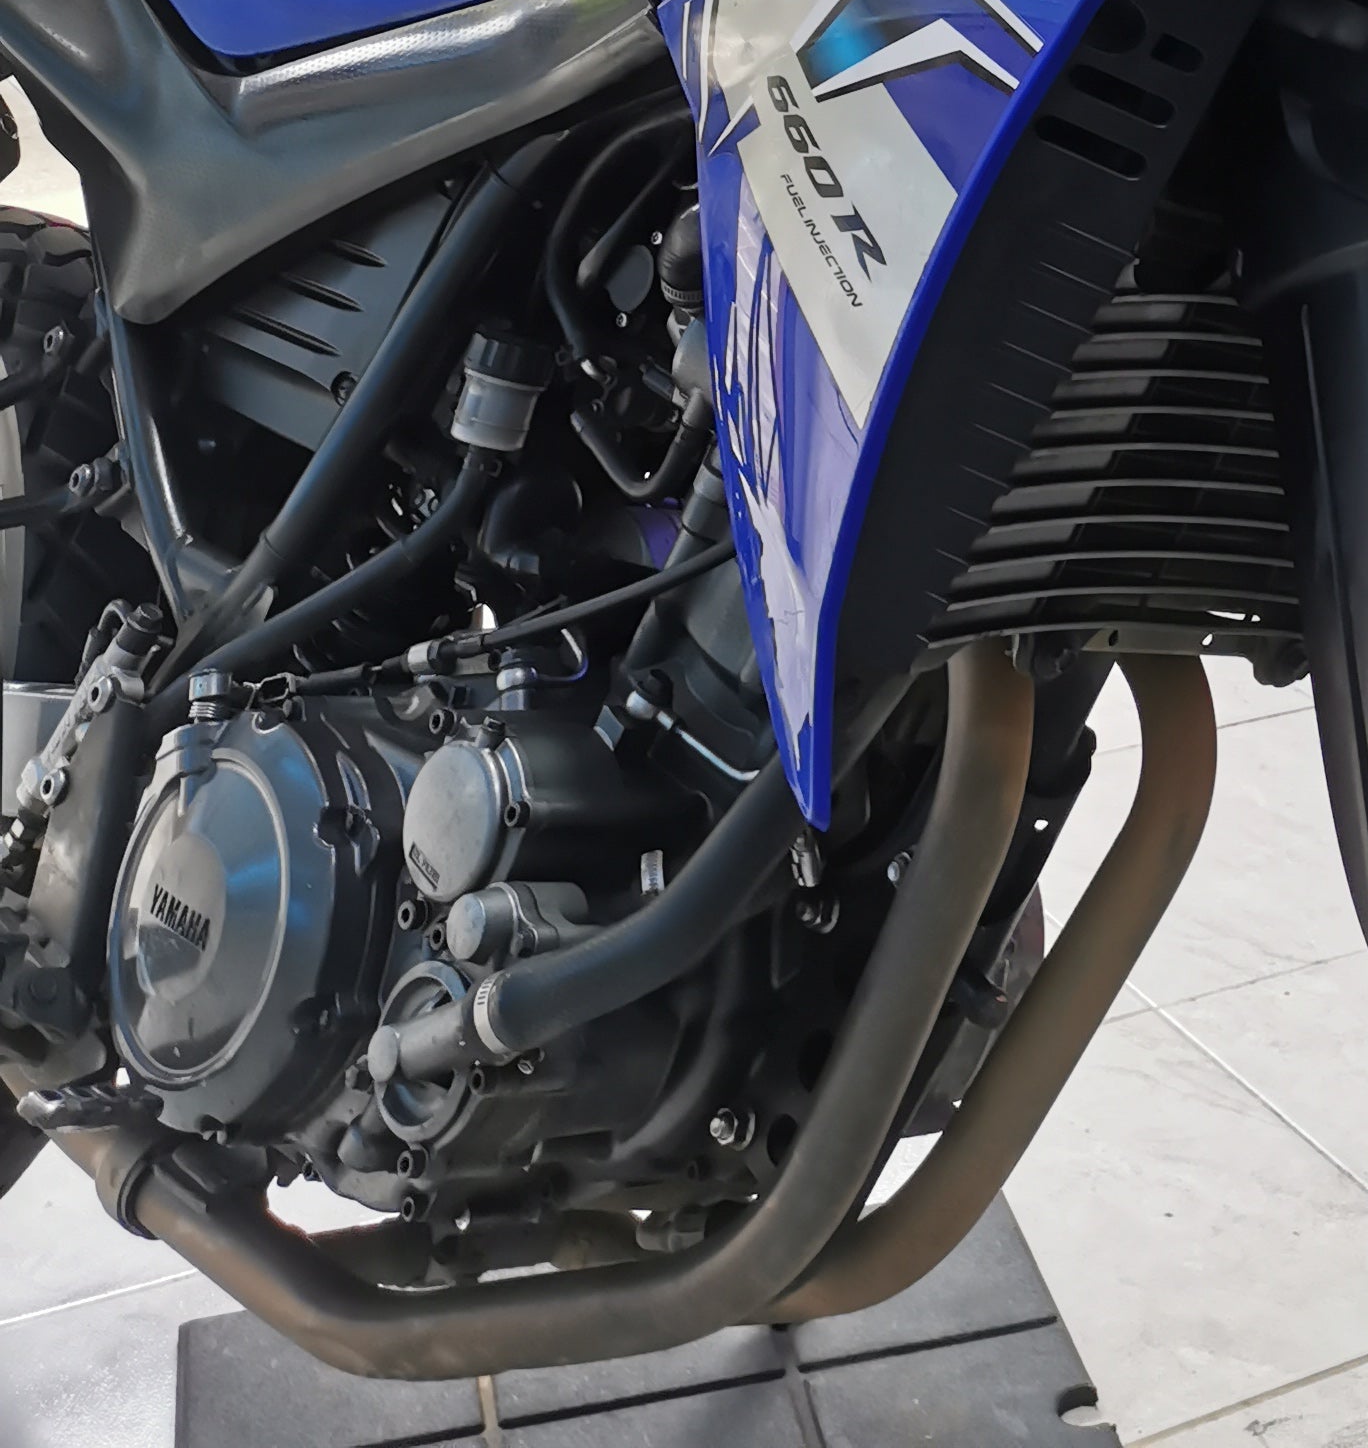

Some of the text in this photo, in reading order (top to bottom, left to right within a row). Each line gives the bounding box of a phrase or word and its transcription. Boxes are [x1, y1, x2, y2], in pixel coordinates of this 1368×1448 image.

[766, 74, 888, 283] 660 R
[779, 173, 864, 308] FUEL INJECTION
[150, 882, 211, 952] YAMAHA
